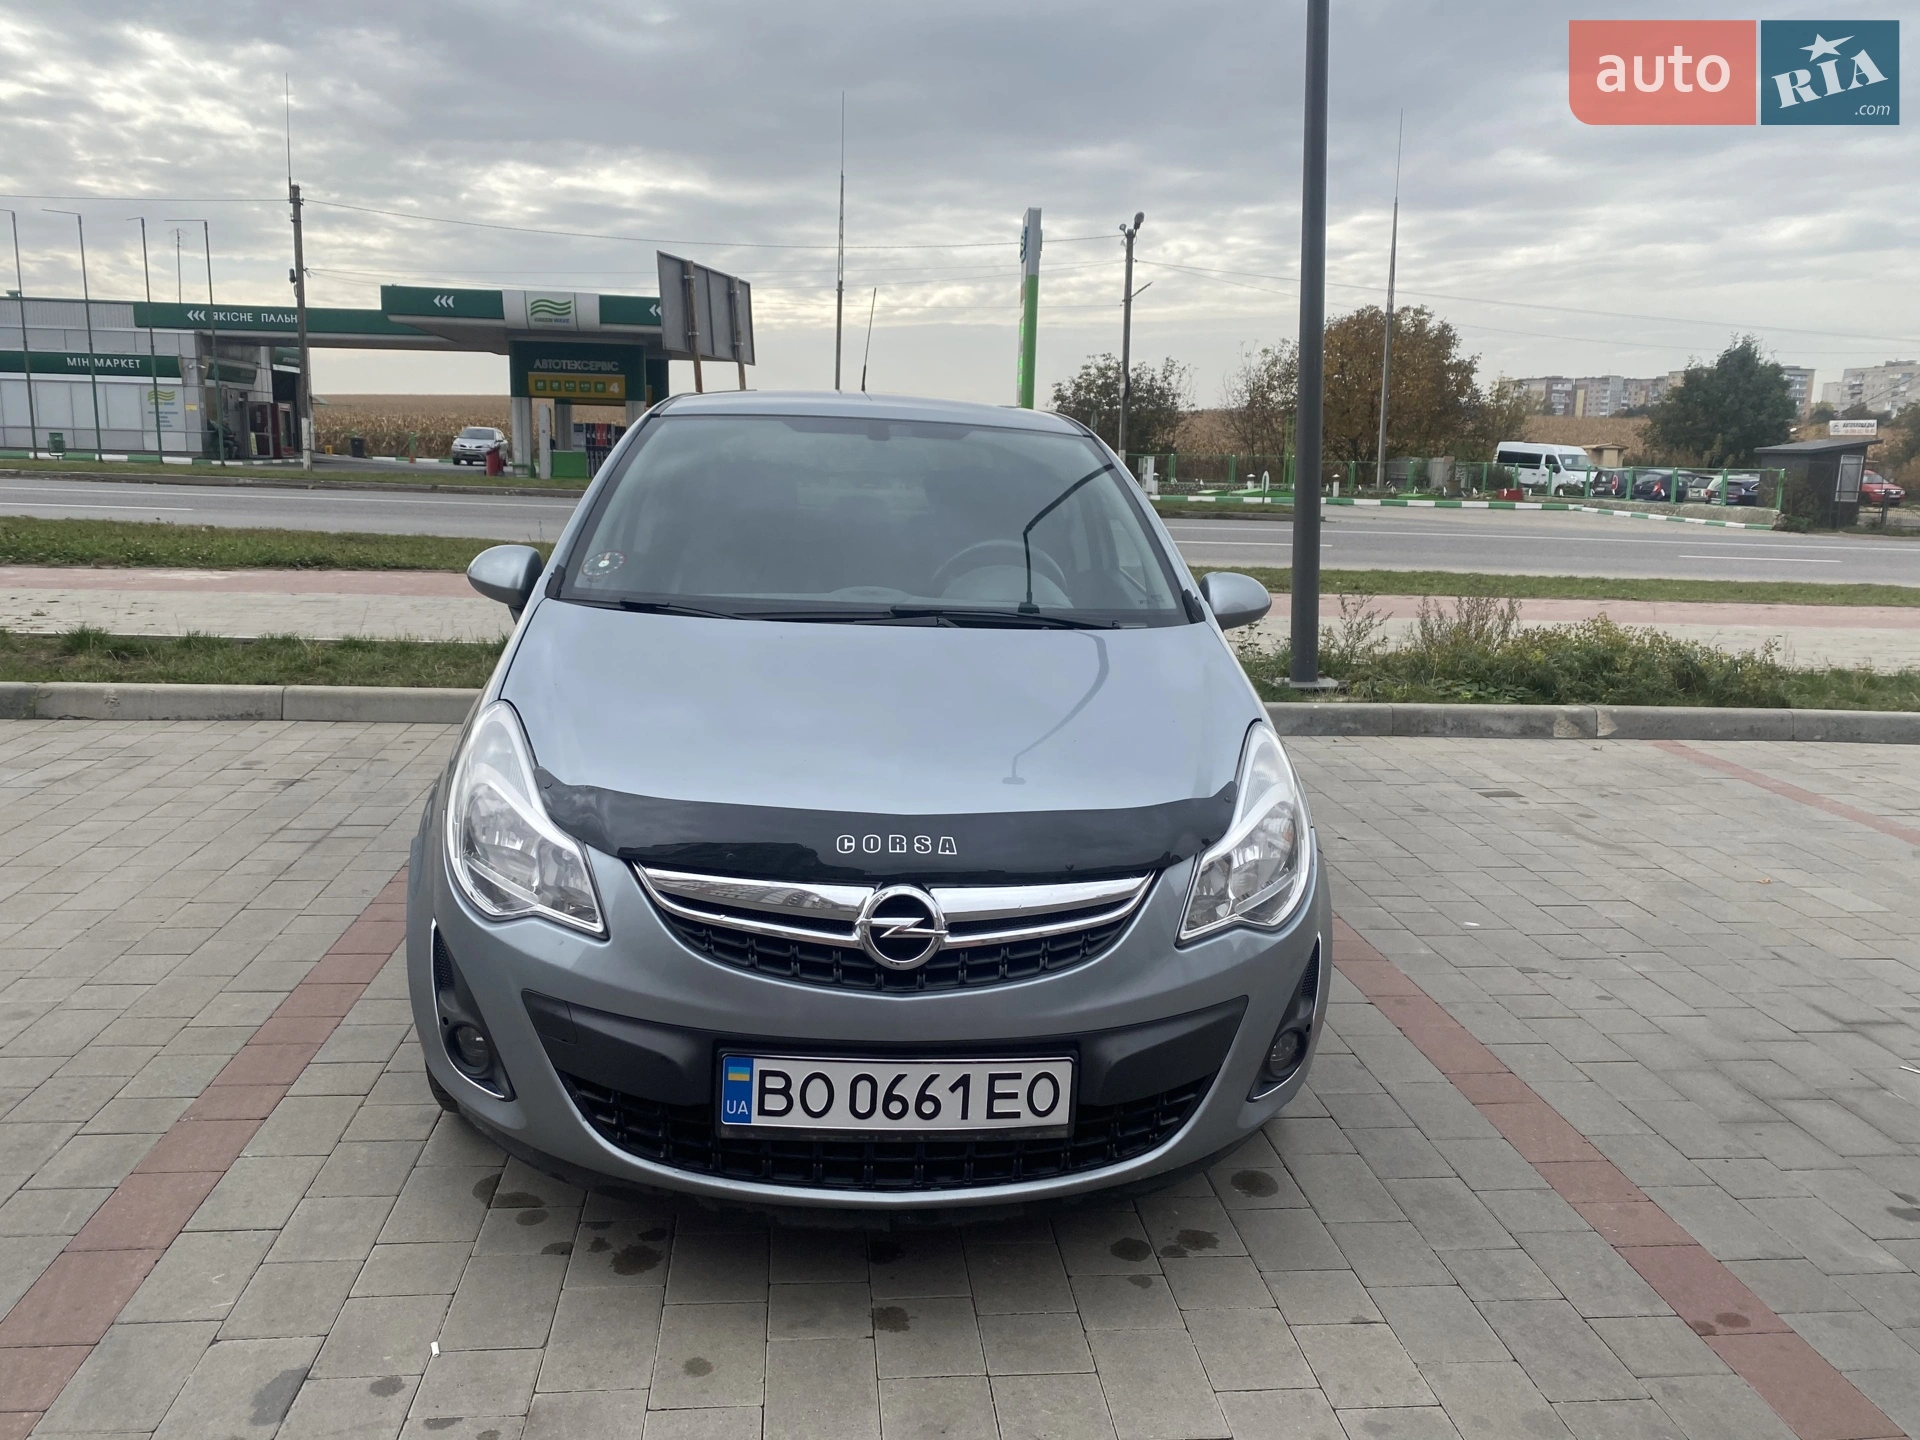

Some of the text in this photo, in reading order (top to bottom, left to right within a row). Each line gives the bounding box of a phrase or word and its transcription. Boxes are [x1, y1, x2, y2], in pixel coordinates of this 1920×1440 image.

[213, 312, 254, 322] ЯКІСНЕ
[533, 358, 619, 372] АВТОТЕХСЕРВІС
[836, 834, 957, 855] CORSA
[757, 1069, 1061, 1121] BO 0661 EO
[726, 1100, 749, 1115] UA
